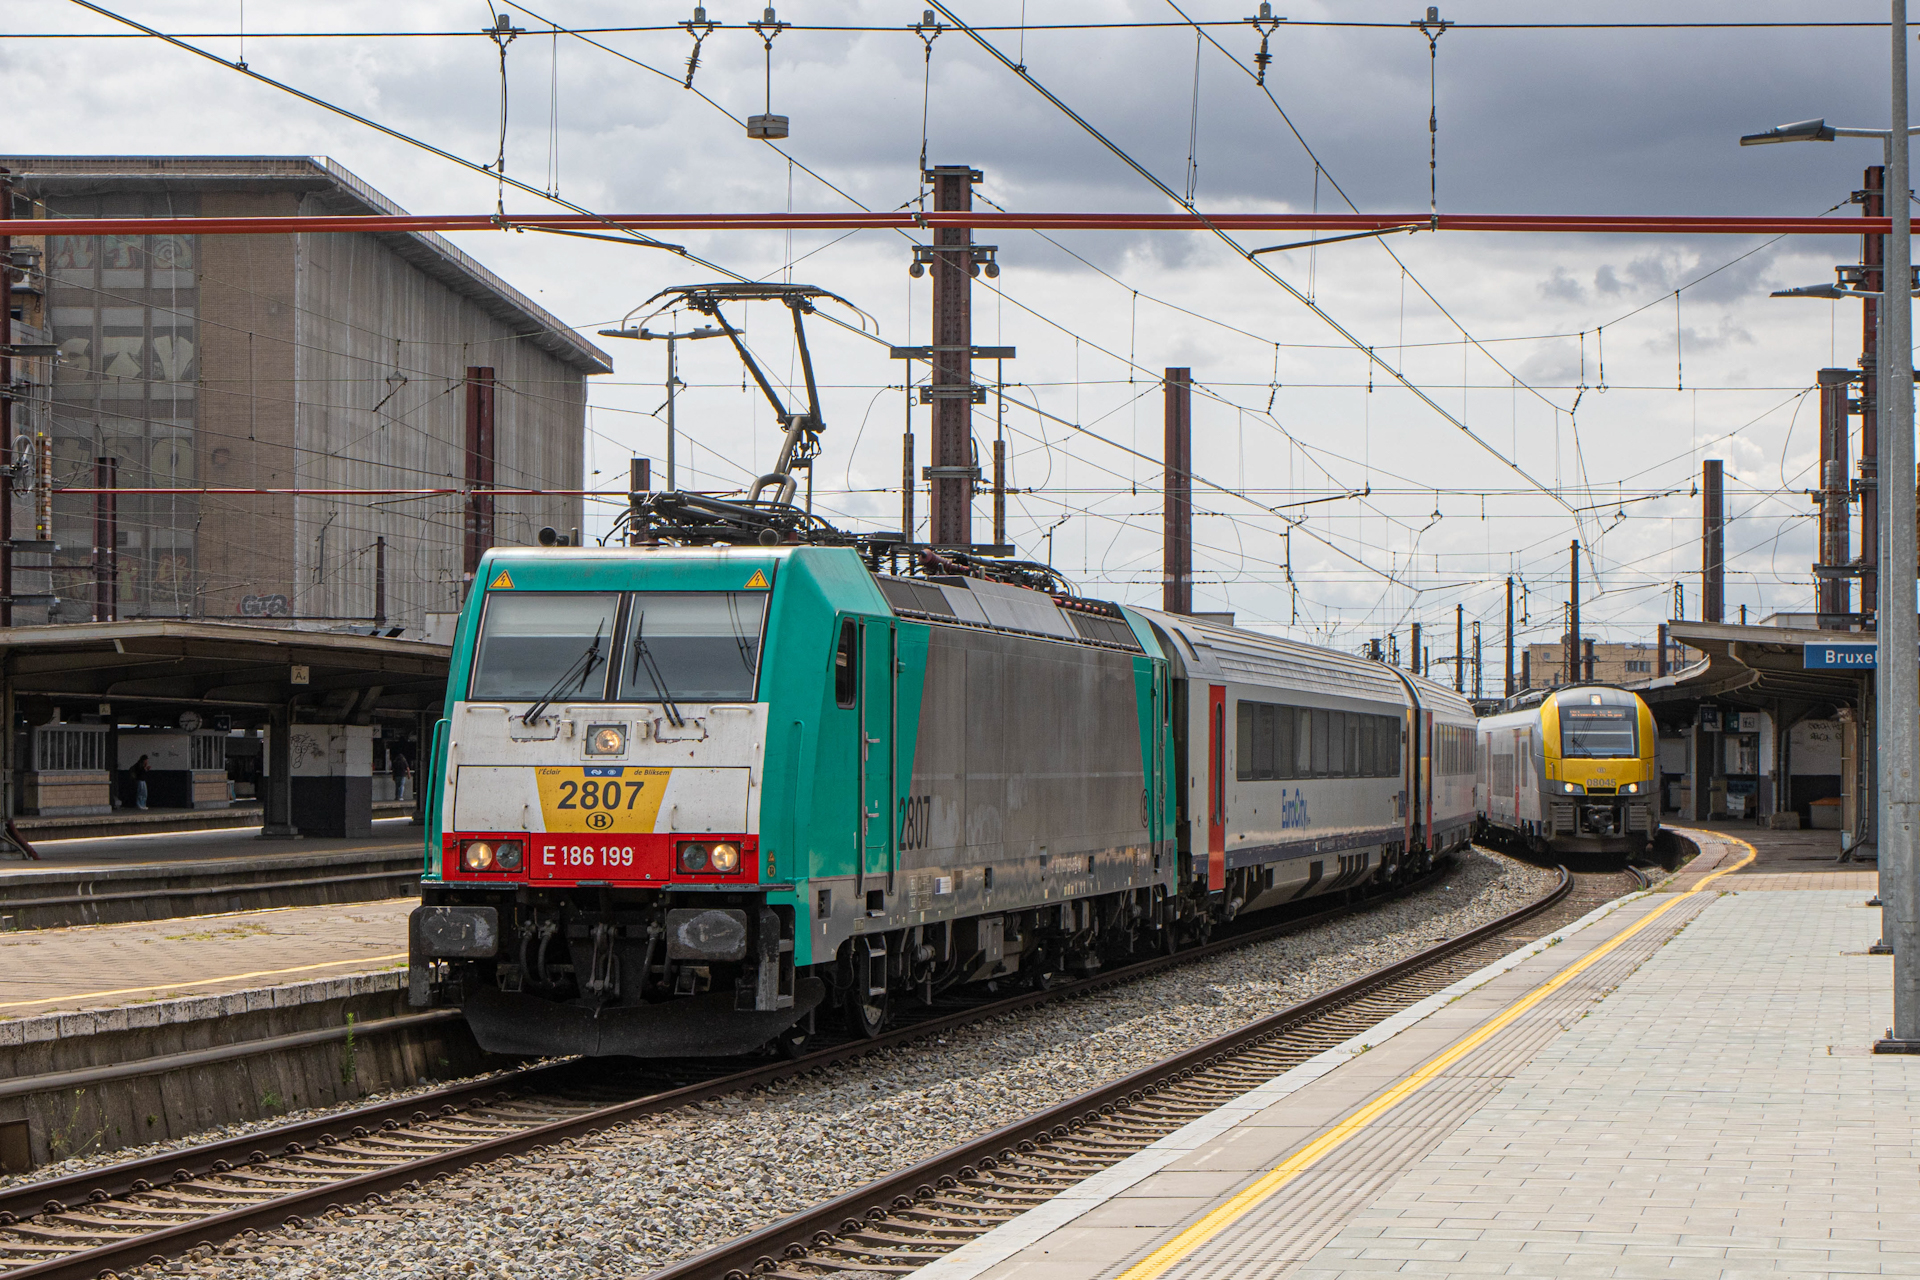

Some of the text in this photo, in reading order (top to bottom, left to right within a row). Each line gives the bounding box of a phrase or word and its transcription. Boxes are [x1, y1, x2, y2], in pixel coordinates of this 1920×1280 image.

[644, 768, 670, 776] Bliksem
[1586, 778, 1617, 787] 08045
[557, 781, 644, 810] 2807
[899, 795, 931, 851] 2807
[543, 845, 634, 866] E 186 199
